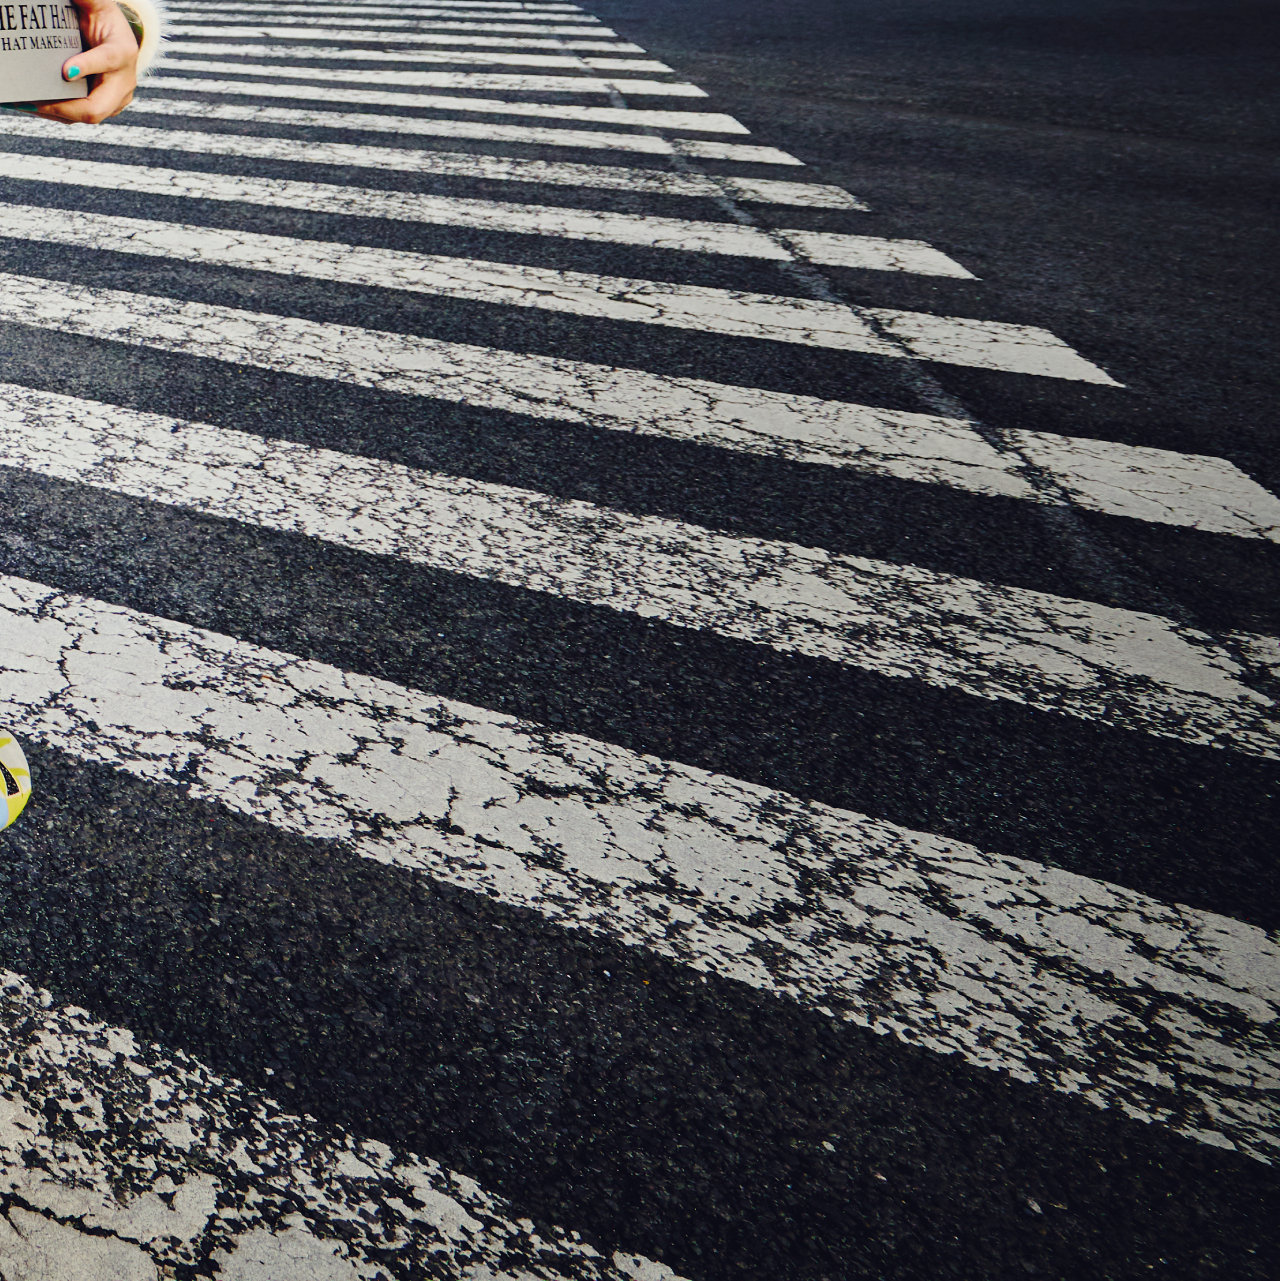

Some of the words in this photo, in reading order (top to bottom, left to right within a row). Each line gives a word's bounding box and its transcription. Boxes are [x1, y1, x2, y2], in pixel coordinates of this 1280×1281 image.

[18, 4, 48, 30] FAT
[1, 36, 28, 51] HAT
[29, 35, 62, 50] MAKES
